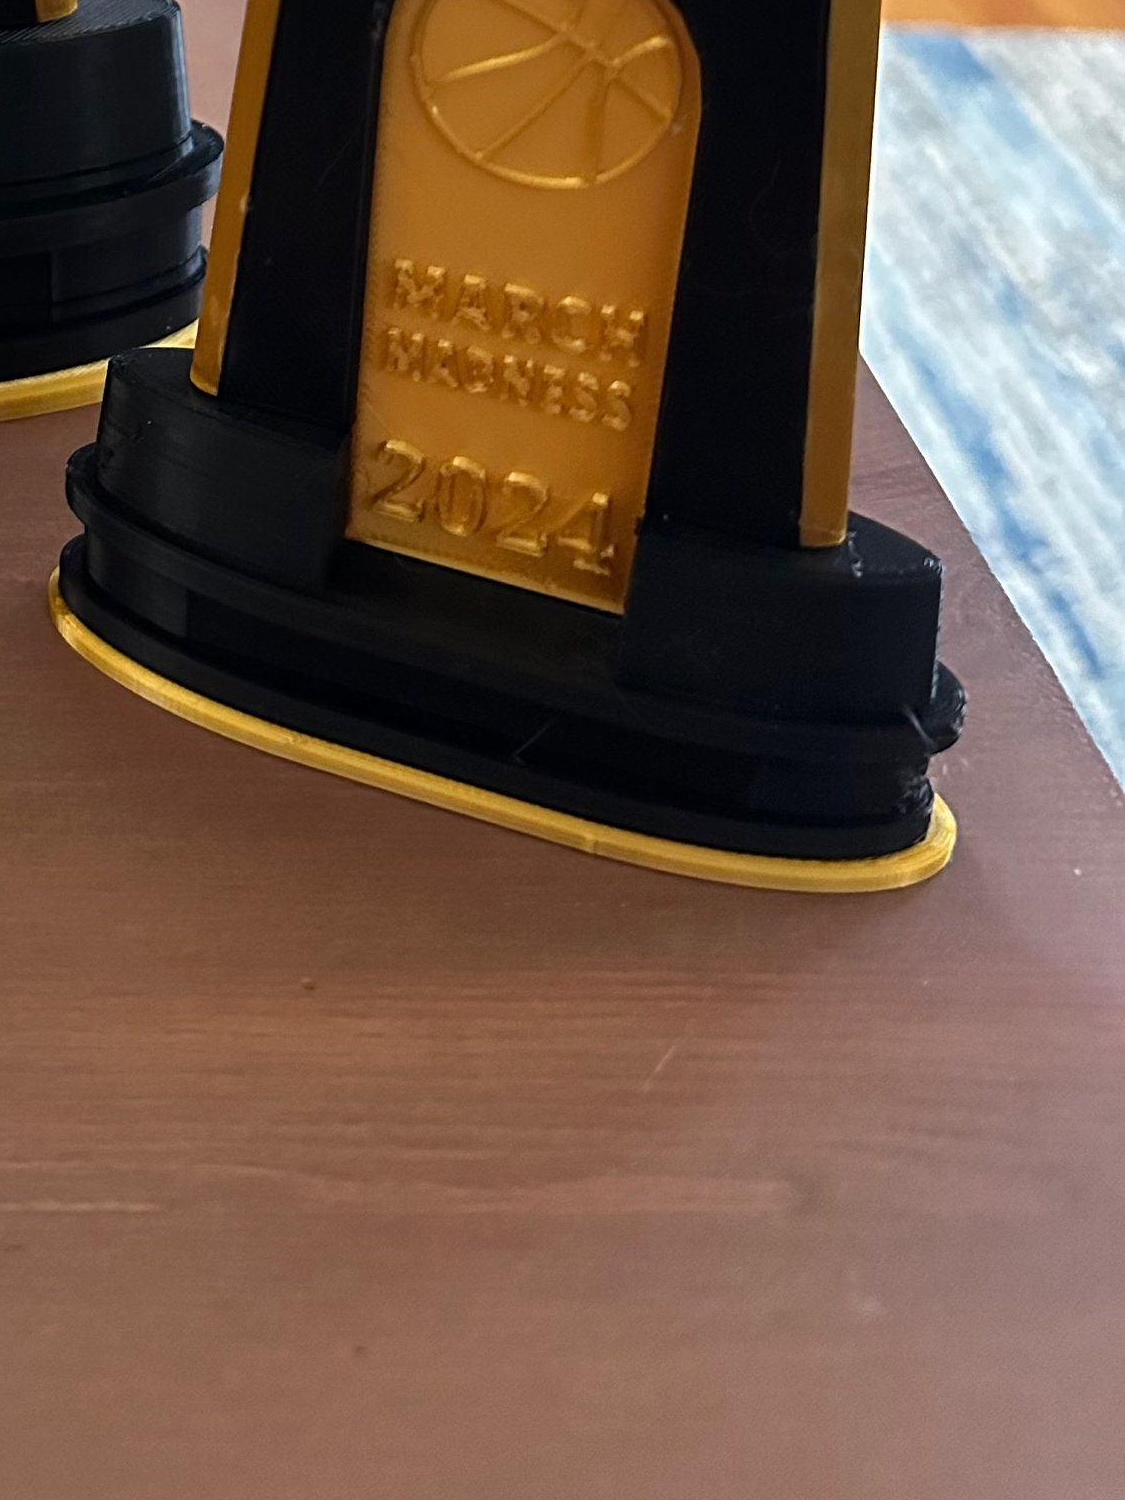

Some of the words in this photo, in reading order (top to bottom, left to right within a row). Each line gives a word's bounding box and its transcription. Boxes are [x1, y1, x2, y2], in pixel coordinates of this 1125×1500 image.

[392, 258, 646, 368] MARCH
[385, 326, 632, 432] MADNESS
[368, 438, 616, 577] 2024
